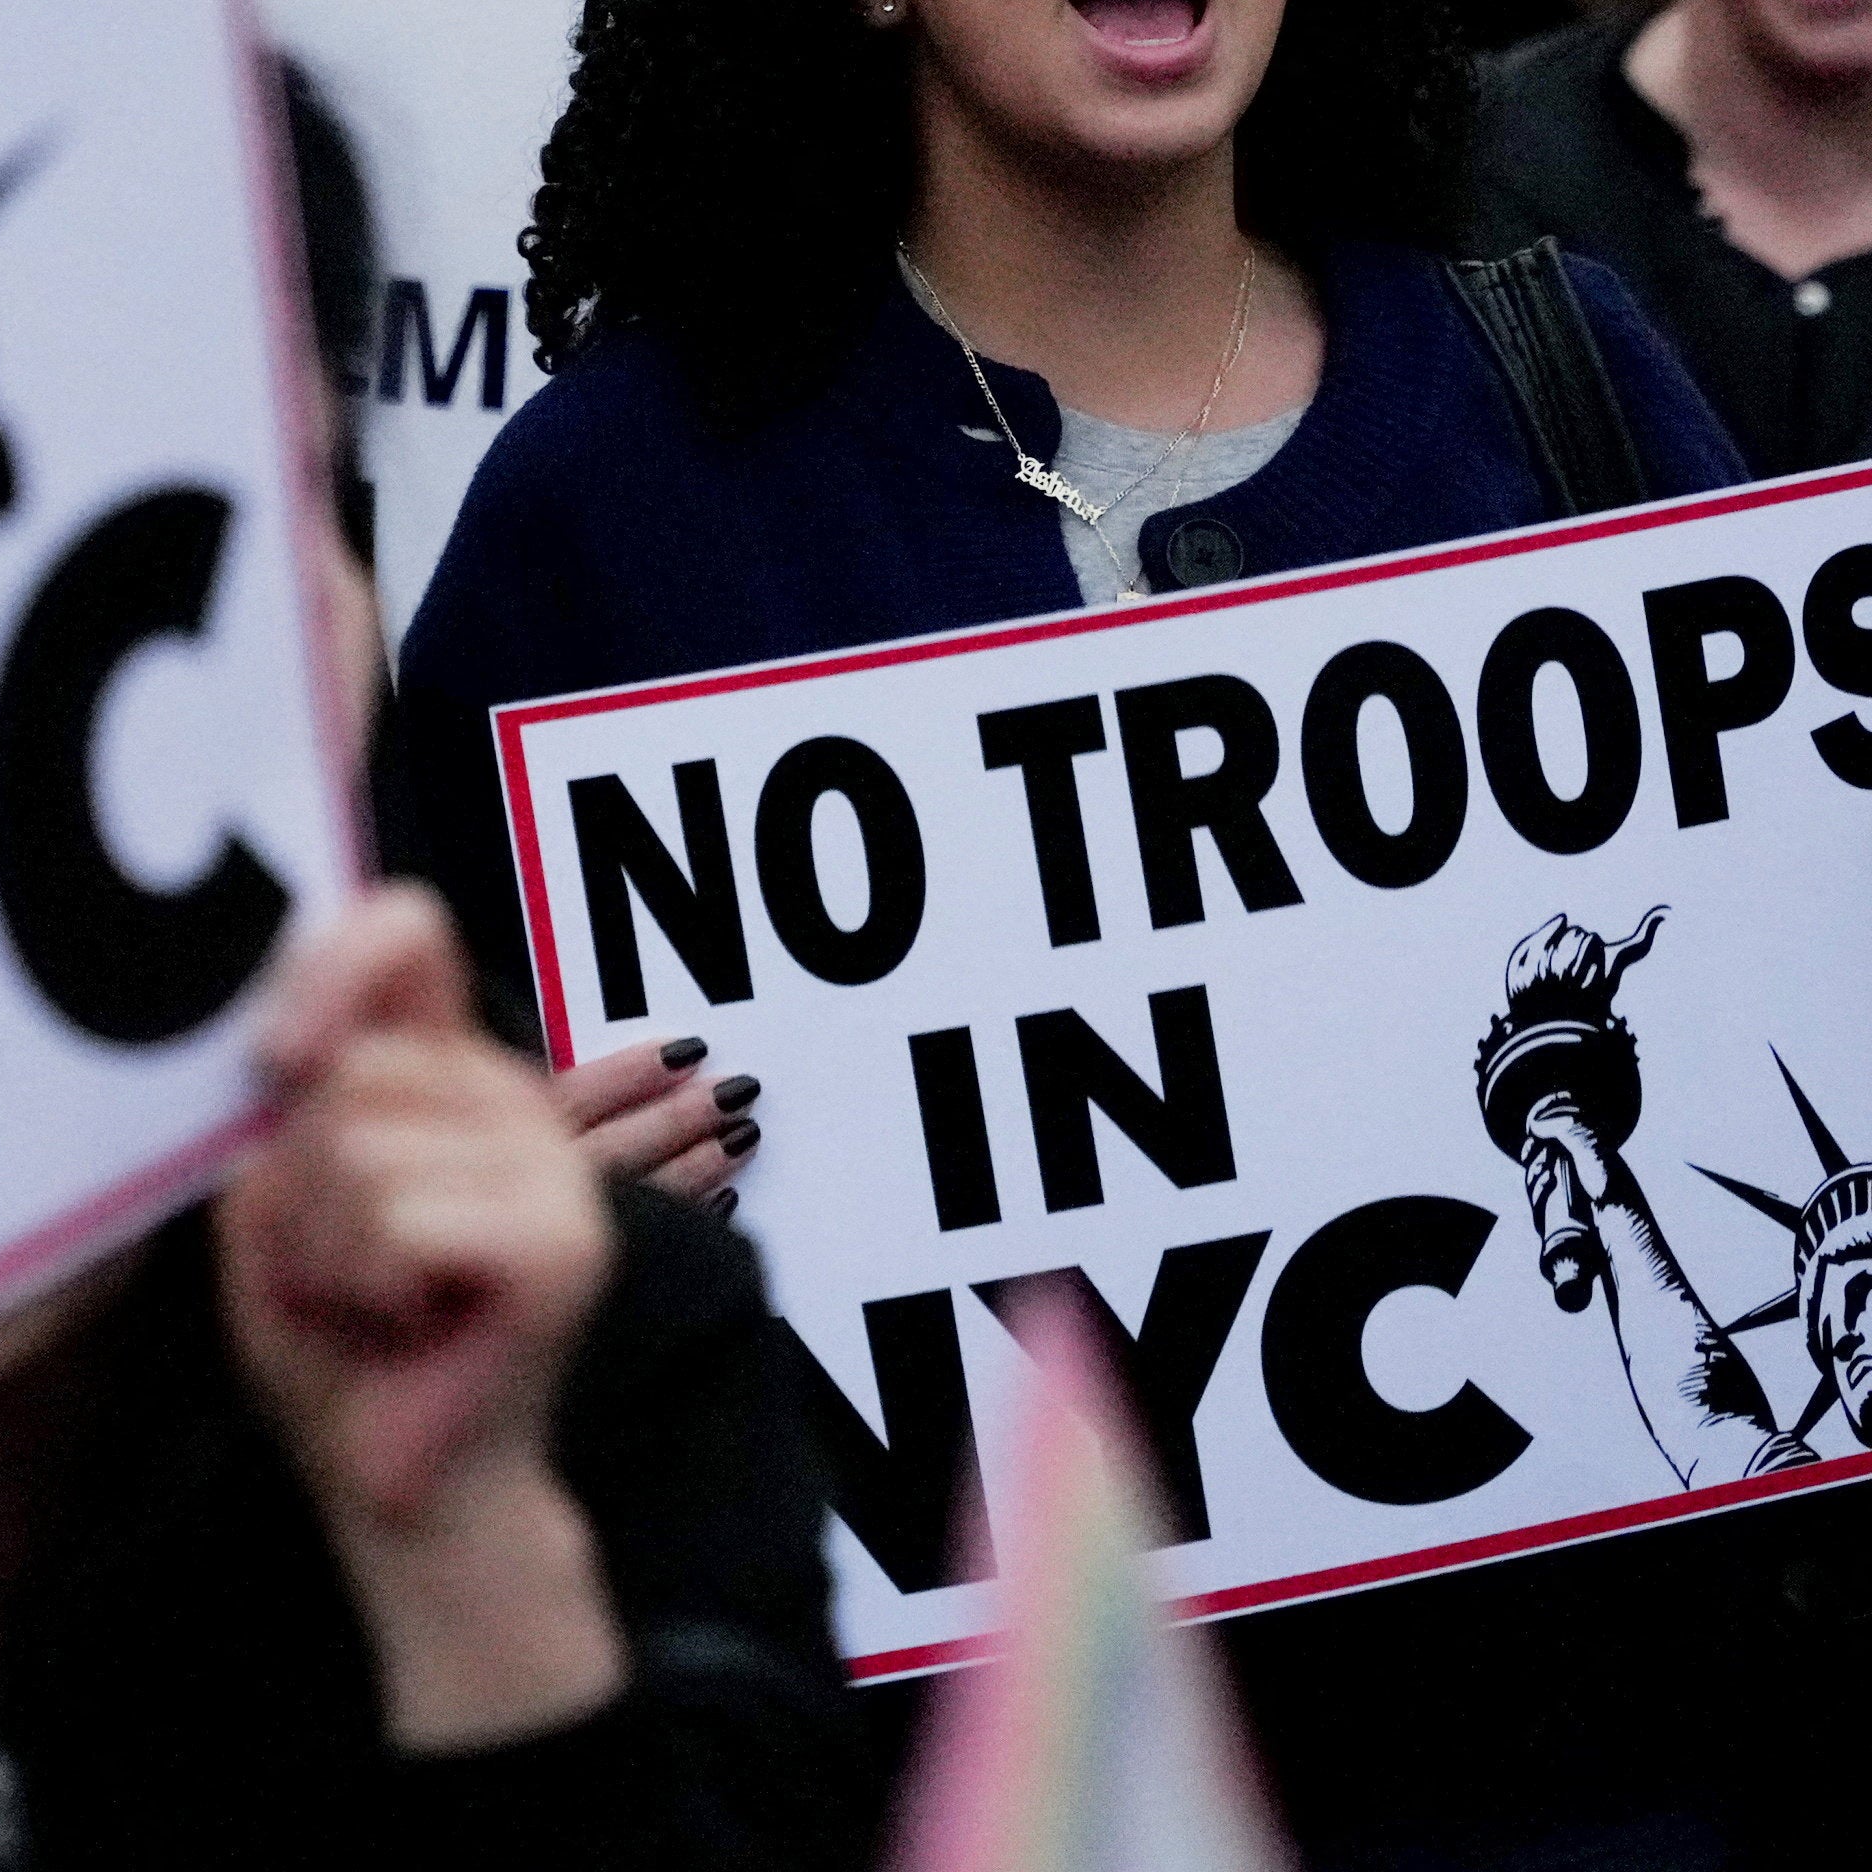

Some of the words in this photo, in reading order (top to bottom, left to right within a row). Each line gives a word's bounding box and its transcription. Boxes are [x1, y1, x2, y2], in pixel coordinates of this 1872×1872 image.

[566, 733, 926, 1023] NO
[908, 982, 1240, 1232] IN
[770, 1192, 1534, 1596] NYC
